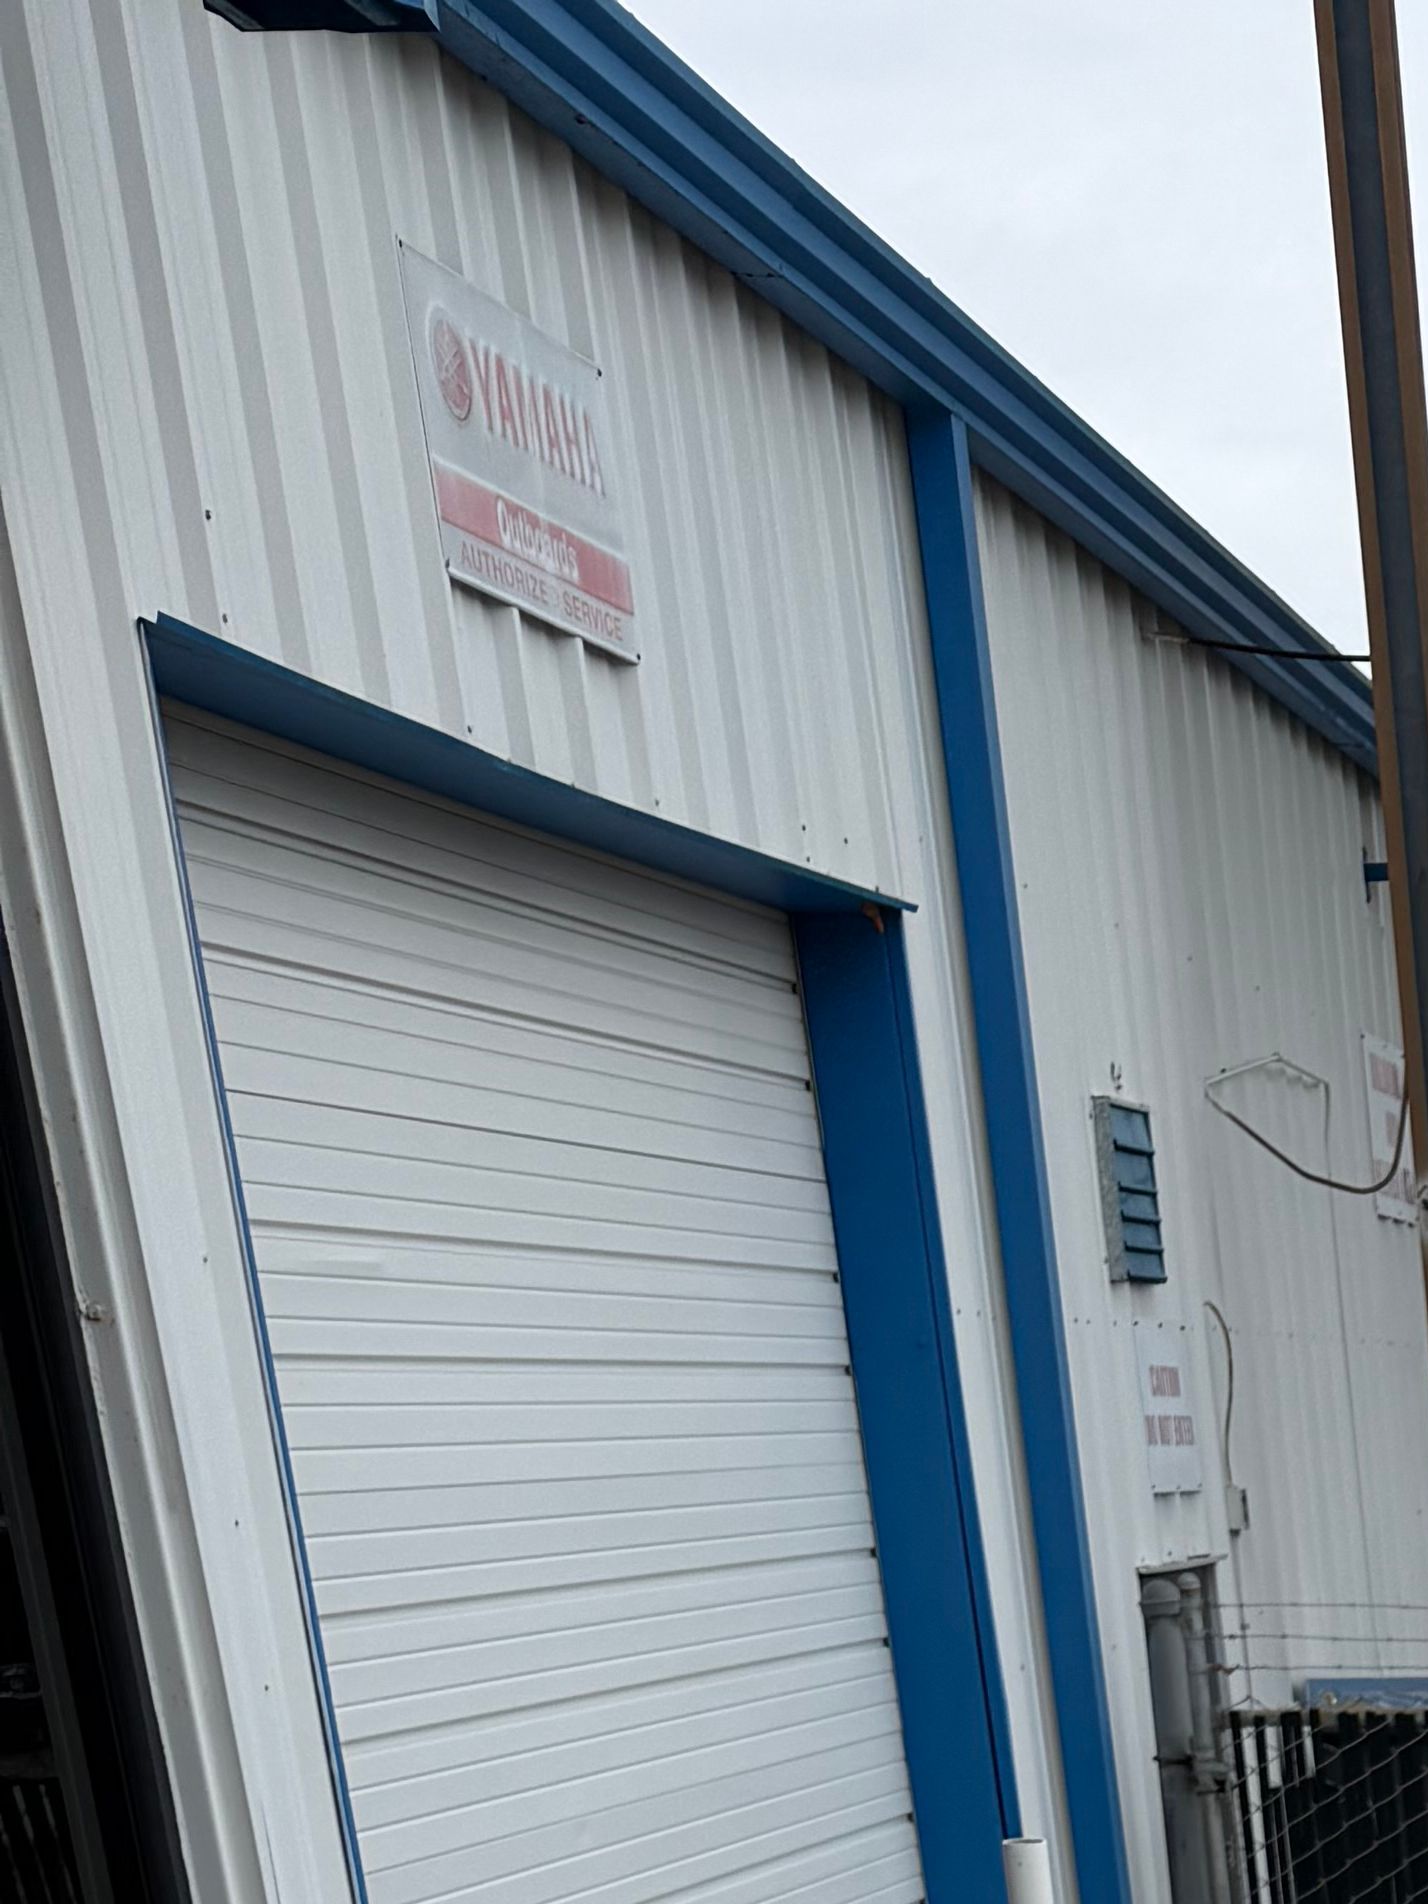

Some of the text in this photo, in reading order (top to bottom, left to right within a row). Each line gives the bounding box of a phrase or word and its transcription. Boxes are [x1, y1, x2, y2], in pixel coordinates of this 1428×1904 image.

[468, 335, 606, 499] YAMAHA
[496, 497, 580, 585] Outboards
[563, 590, 624, 642] SERVICE
